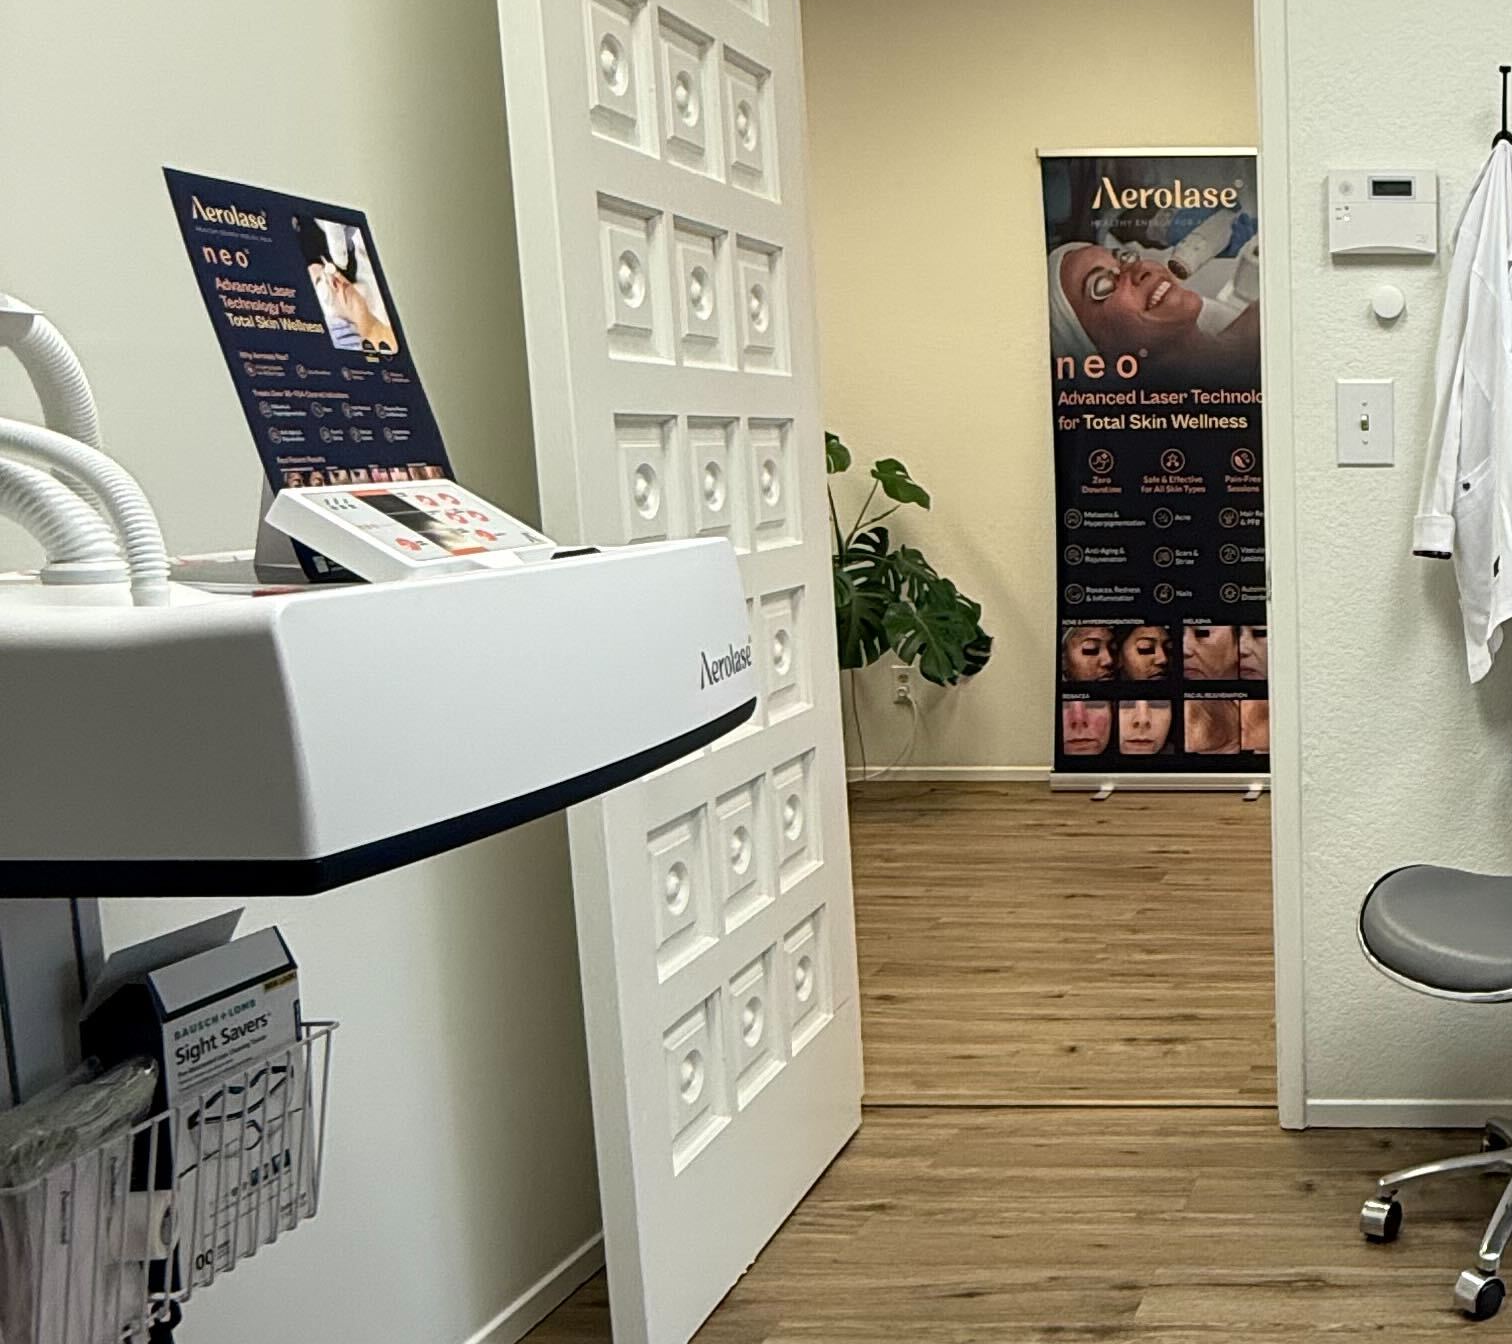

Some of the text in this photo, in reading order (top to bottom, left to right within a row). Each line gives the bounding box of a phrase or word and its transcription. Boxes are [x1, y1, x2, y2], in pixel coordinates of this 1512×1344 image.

[215, 277, 298, 298] Advanced Laser
[219, 296, 297, 316] Technology for
[225, 312, 325, 334] Total Skin Wellness
[1058, 390, 1136, 406] Advanced
[1140, 390, 1188, 405] Laser
[1058, 414, 1248, 431] for Total Skin Wellness
[174, 1014, 219, 1041] BAUSCH
[228, 999, 256, 1017] LOMB
[175, 1013, 268, 1065] Sight Savers
